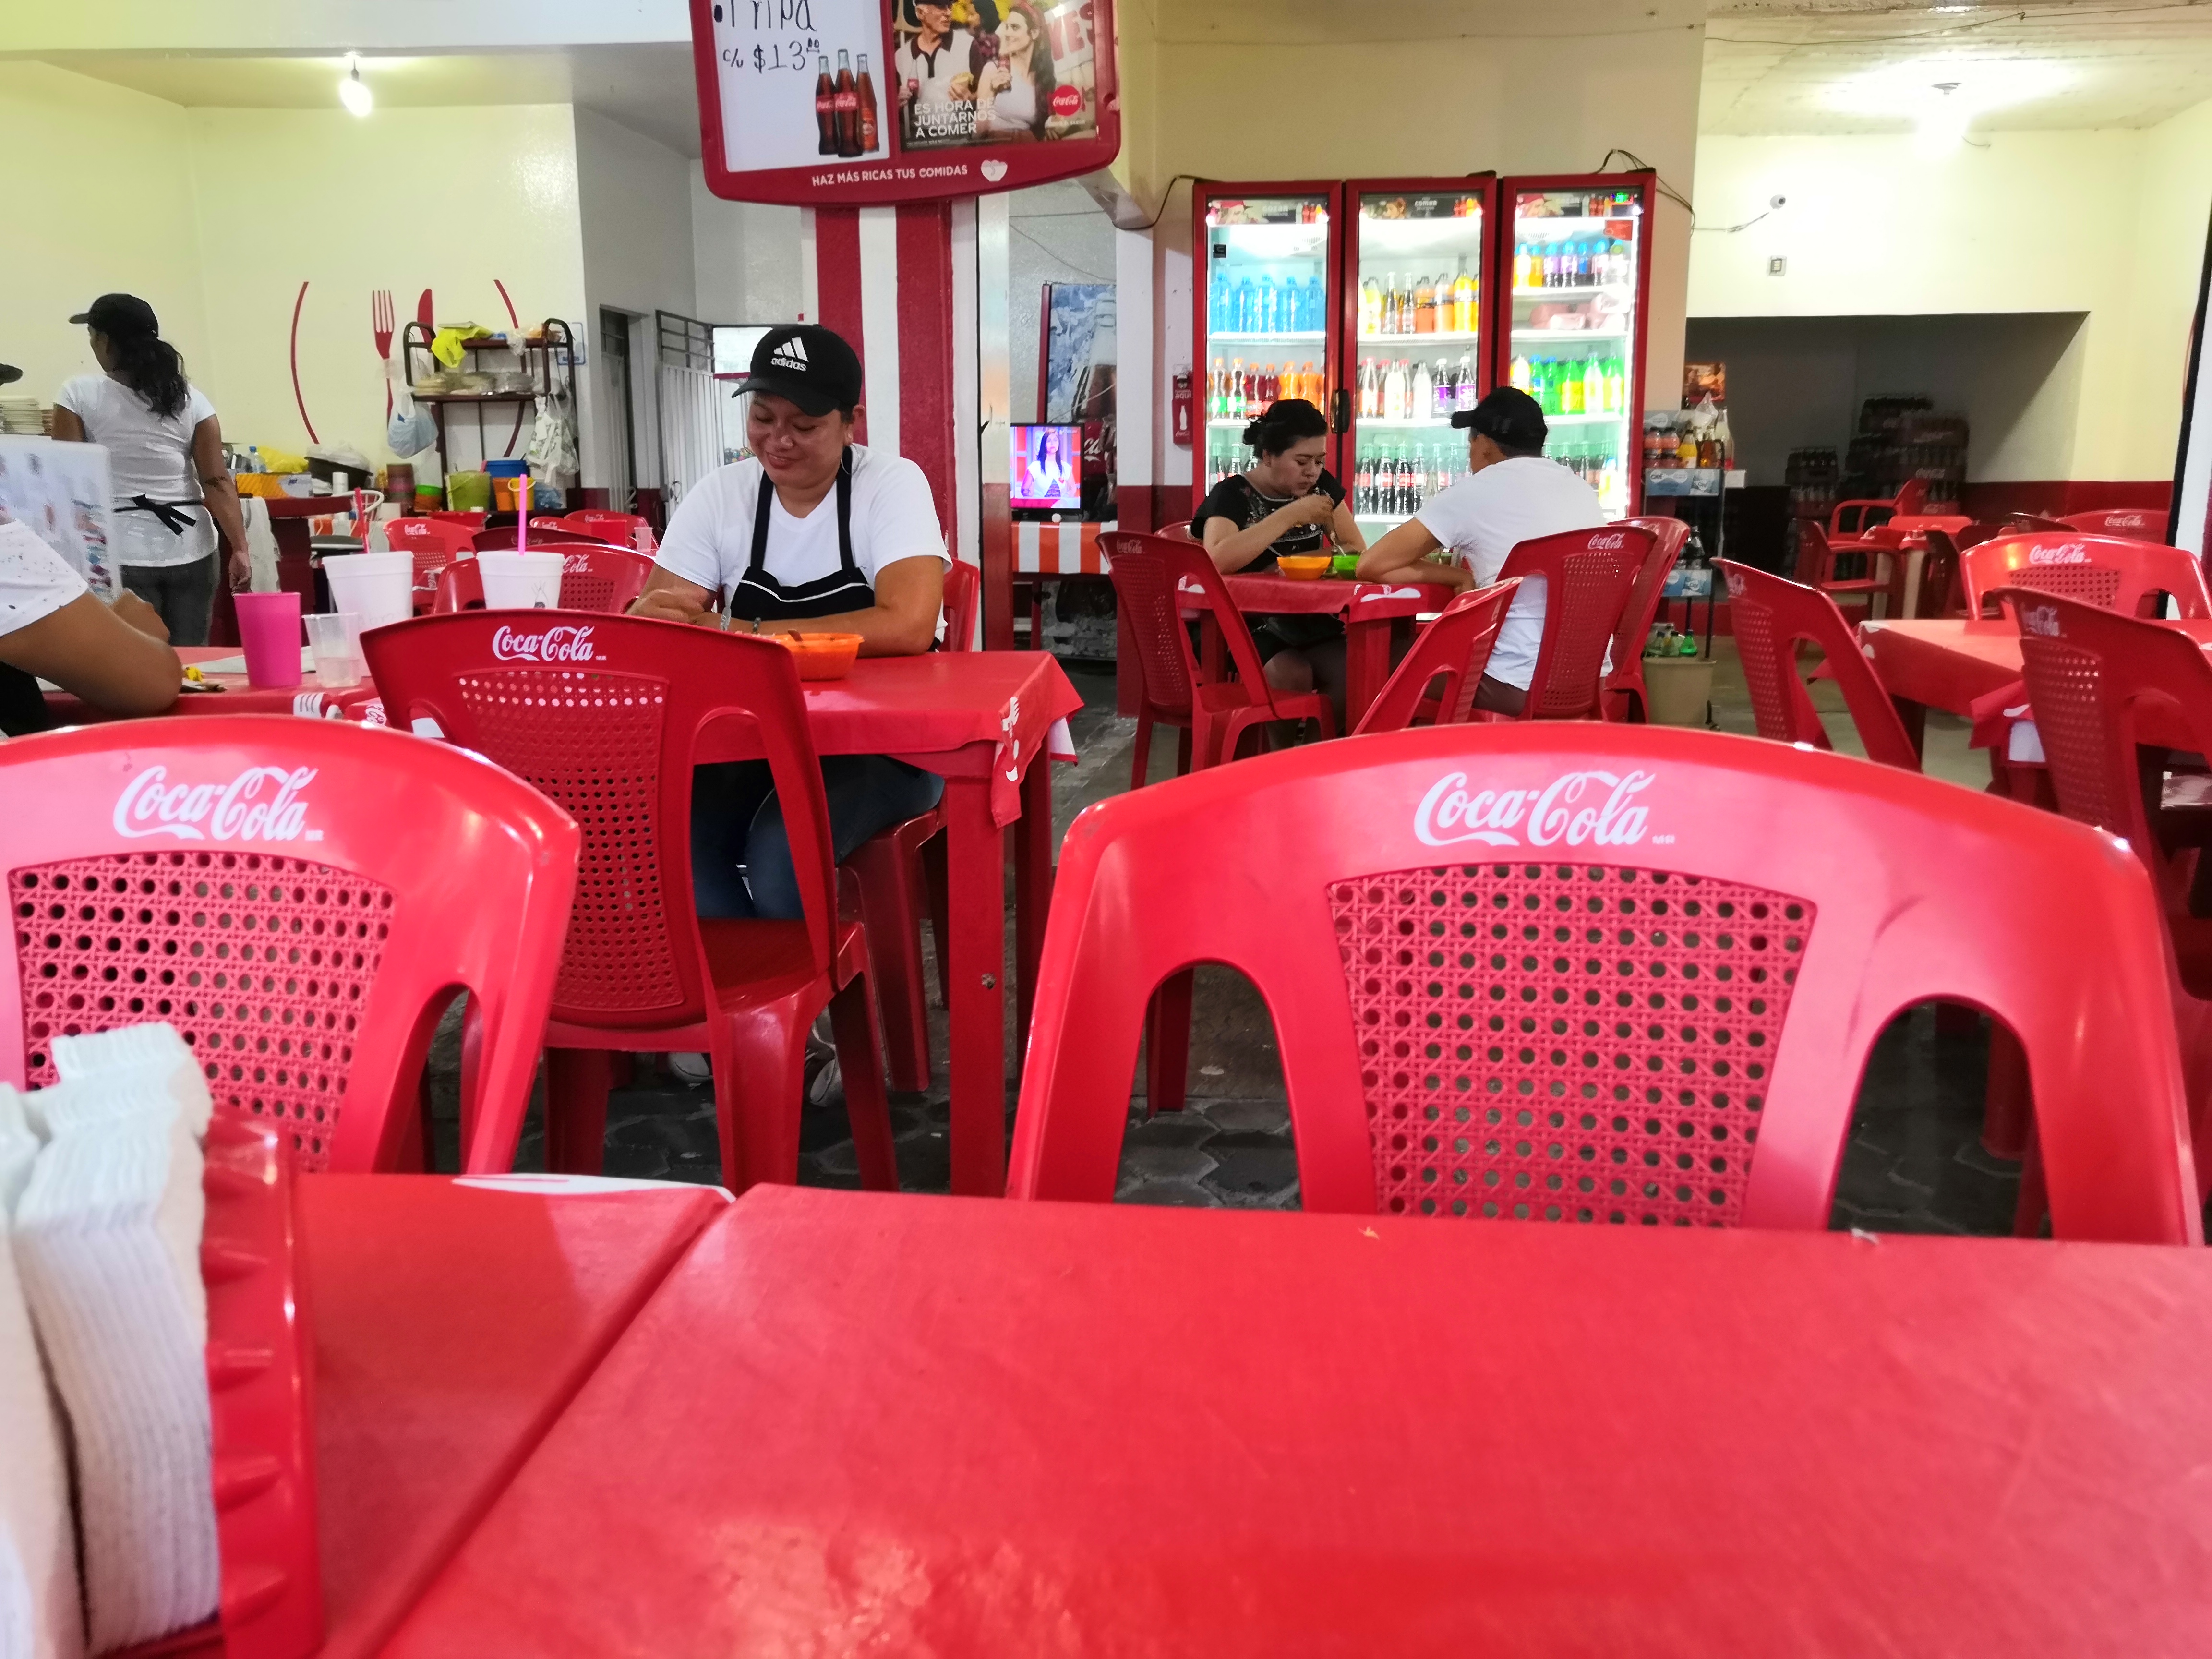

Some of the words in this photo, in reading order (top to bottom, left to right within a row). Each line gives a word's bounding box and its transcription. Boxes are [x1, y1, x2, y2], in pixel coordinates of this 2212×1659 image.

[914, 103, 931, 115] ES
[934, 99, 974, 112] HORA
[977, 96, 994, 109] DE
[915, 109, 997, 127] JUNTARNOS
[915, 125, 926, 138] A
[928, 123, 977, 138] COMER
[812, 175, 834, 187] HAZ
[837, 170, 860, 183] MÁS
[862, 169, 893, 181] RICAS
[895, 168, 916, 180] TUS
[919, 164, 968, 178] COMIDAS
[771, 357, 807, 372] adidas
[2104, 515, 2142, 526] Coca-Cola
[1587, 533, 1624, 549] Coca-Cola
[2029, 543, 2086, 564] Coca-Cola
[493, 625, 595, 661] Coca-Cola
[113, 765, 319, 841] Coca-Cola
[1414, 771, 1656, 846] Coca-Cola
